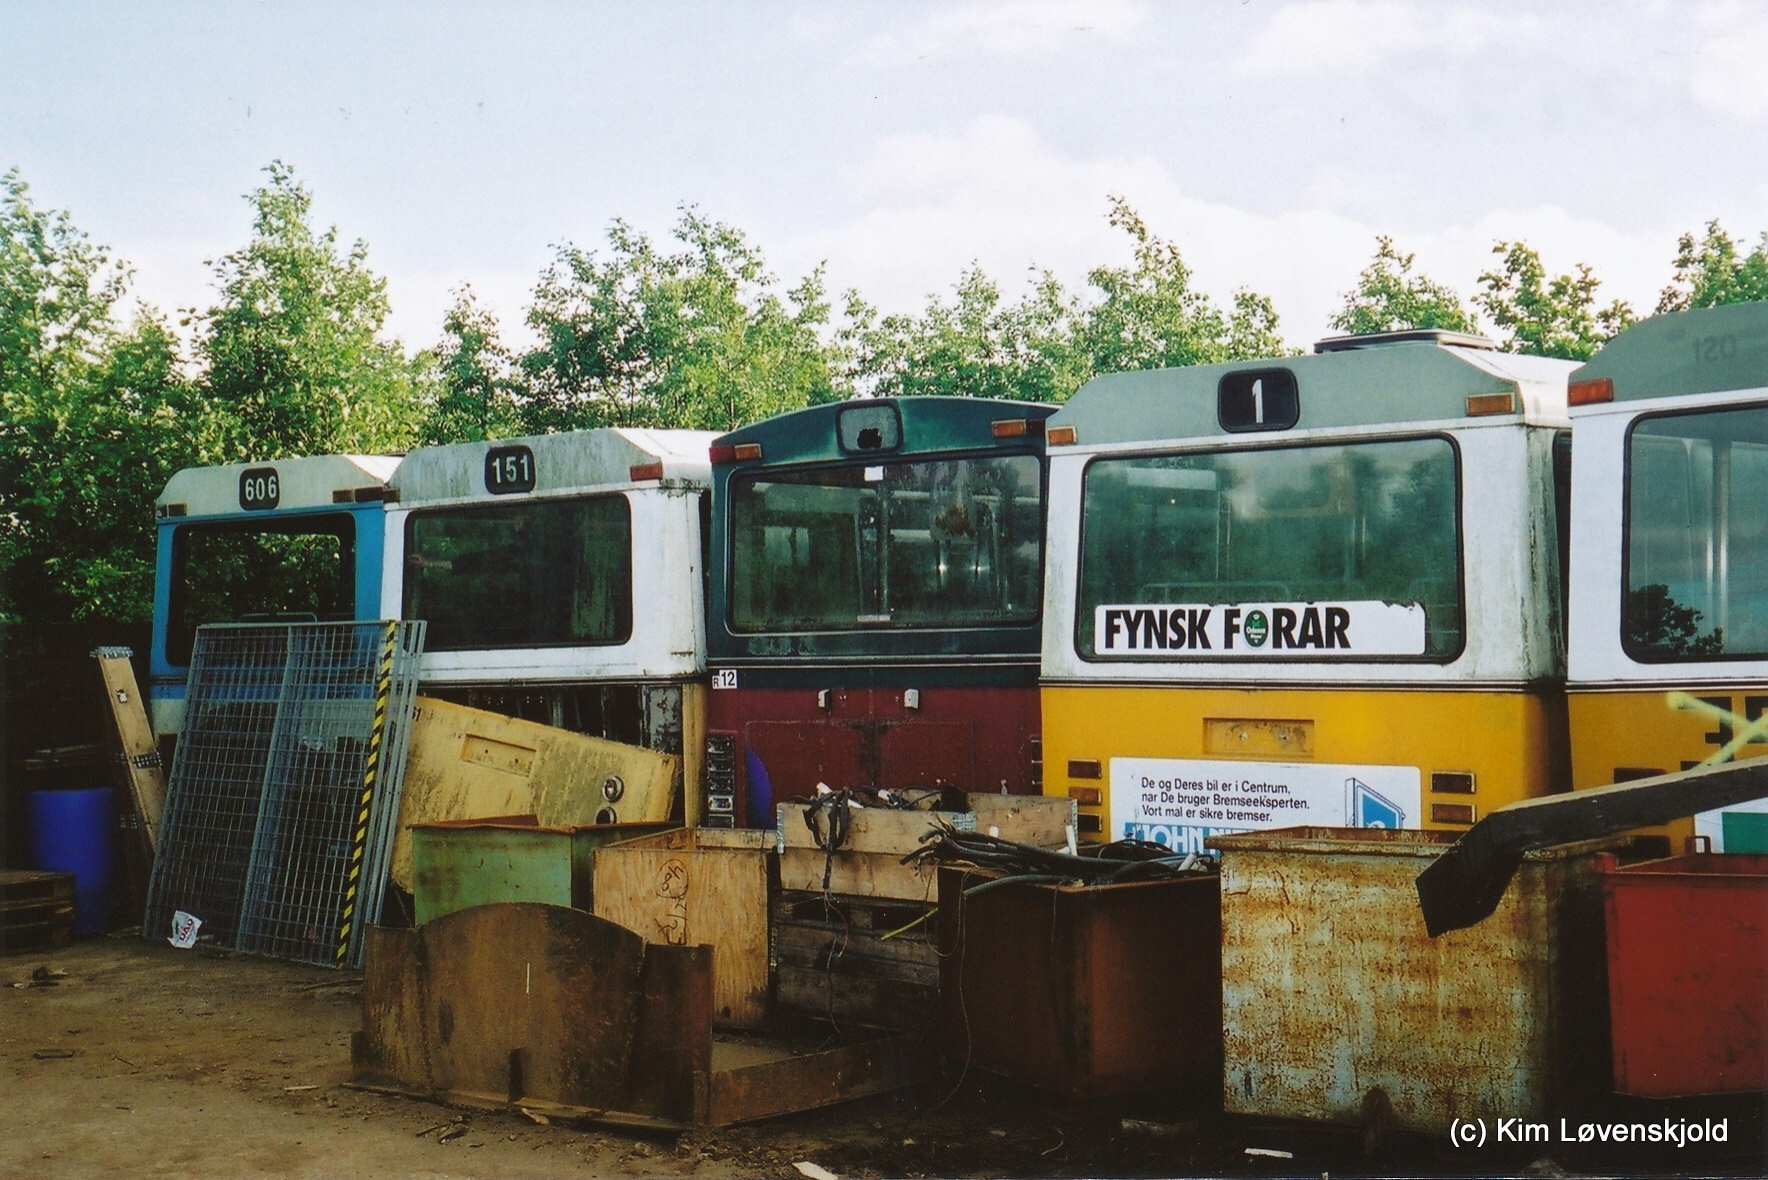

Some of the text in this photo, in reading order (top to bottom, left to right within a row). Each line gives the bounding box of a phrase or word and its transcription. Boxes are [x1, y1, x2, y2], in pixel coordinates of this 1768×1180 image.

[1252, 379, 1263, 423] 1
[492, 454, 530, 484] 151
[245, 475, 277, 501] 606
[1105, 608, 1212, 650] FYNSK
[713, 671, 736, 688] R 12
[1141, 777, 1291, 795] De og Deres bil er i Centrum,
[1160, 791, 1175, 803] De
[1177, 792, 1210, 807] bruger
[1213, 793, 1310, 810] Bremseeksperten.
[1142, 805, 1163, 817] Vort
[1185, 809, 1196, 818] er
[1199, 807, 1224, 820] sikre
[1226, 809, 1273, 822] bremser.
